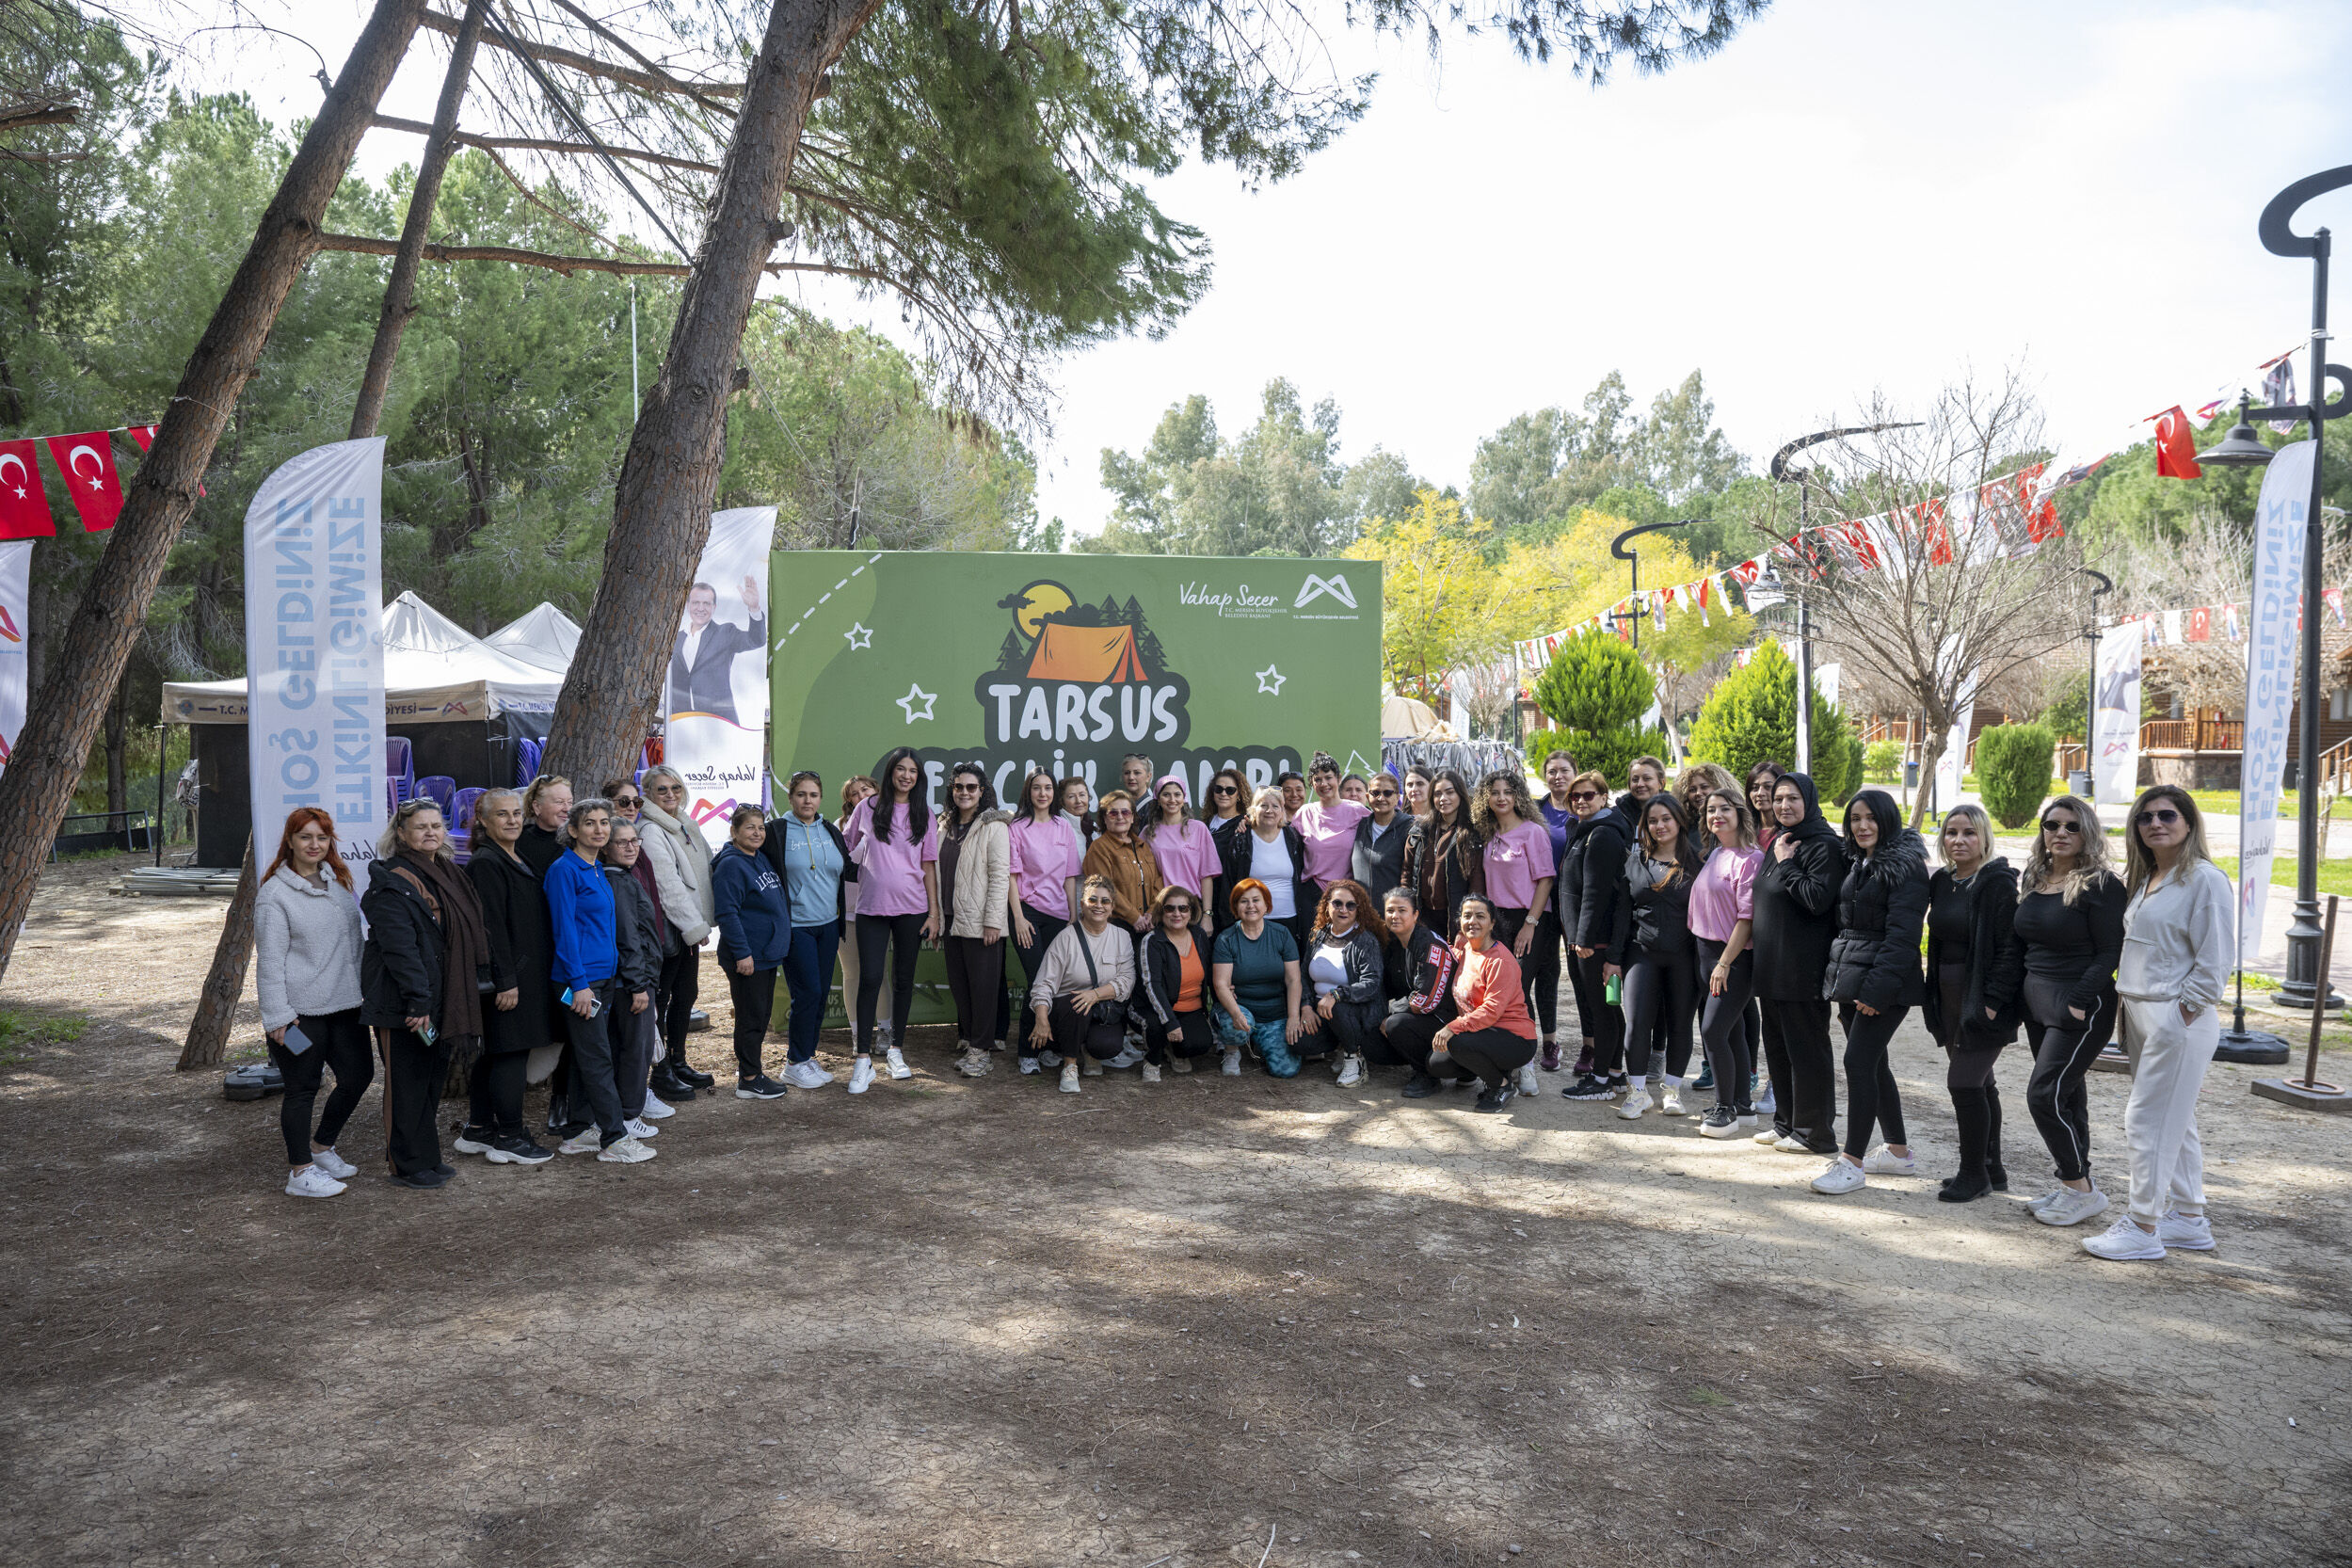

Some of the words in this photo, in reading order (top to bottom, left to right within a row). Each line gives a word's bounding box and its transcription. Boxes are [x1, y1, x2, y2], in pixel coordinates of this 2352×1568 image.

[1179, 581, 1233, 616] Vahap
[1236, 584, 1279, 608] Seçer
[219, 705, 237, 715] T.C.
[988, 683, 1179, 743] TARSUS
